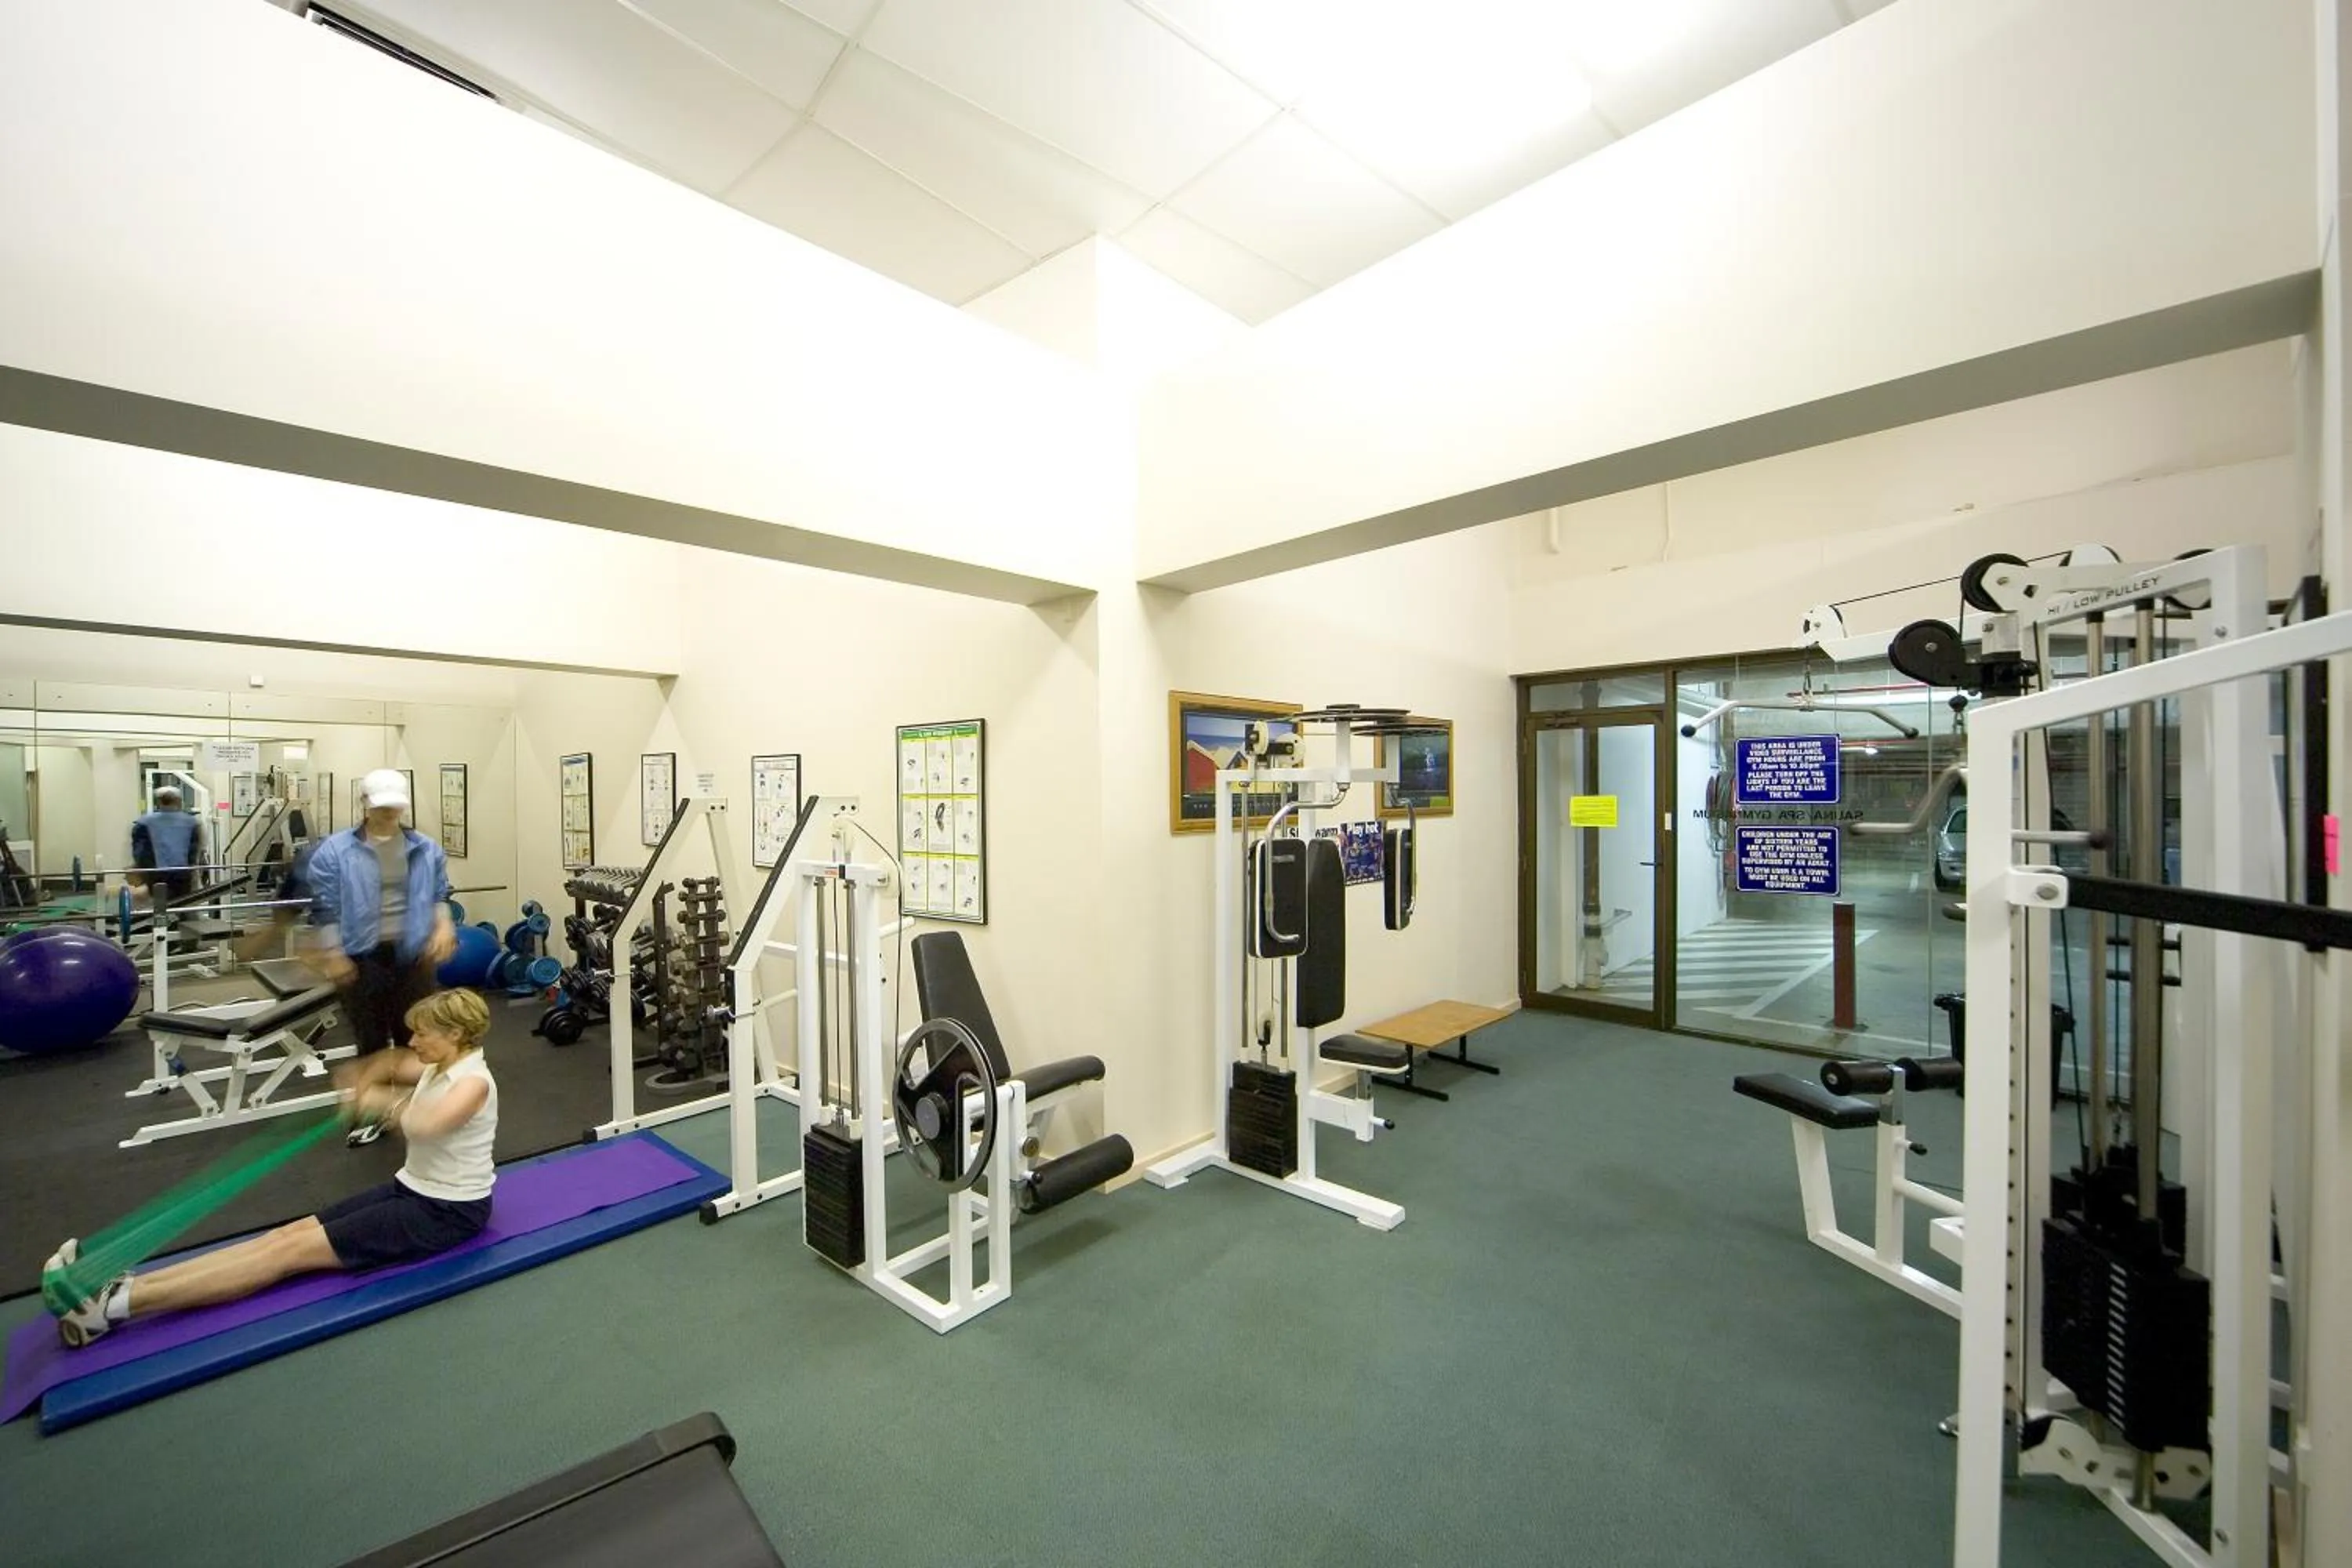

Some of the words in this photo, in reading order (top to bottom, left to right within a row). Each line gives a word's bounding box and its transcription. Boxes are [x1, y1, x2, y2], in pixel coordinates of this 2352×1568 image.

[2047, 605, 2060, 615] HI
[2074, 594, 2100, 608] LOW
[2106, 577, 2159, 599] PULLEY
[1347, 822, 1363, 837] Play
[1365, 821, 1379, 833] hot
